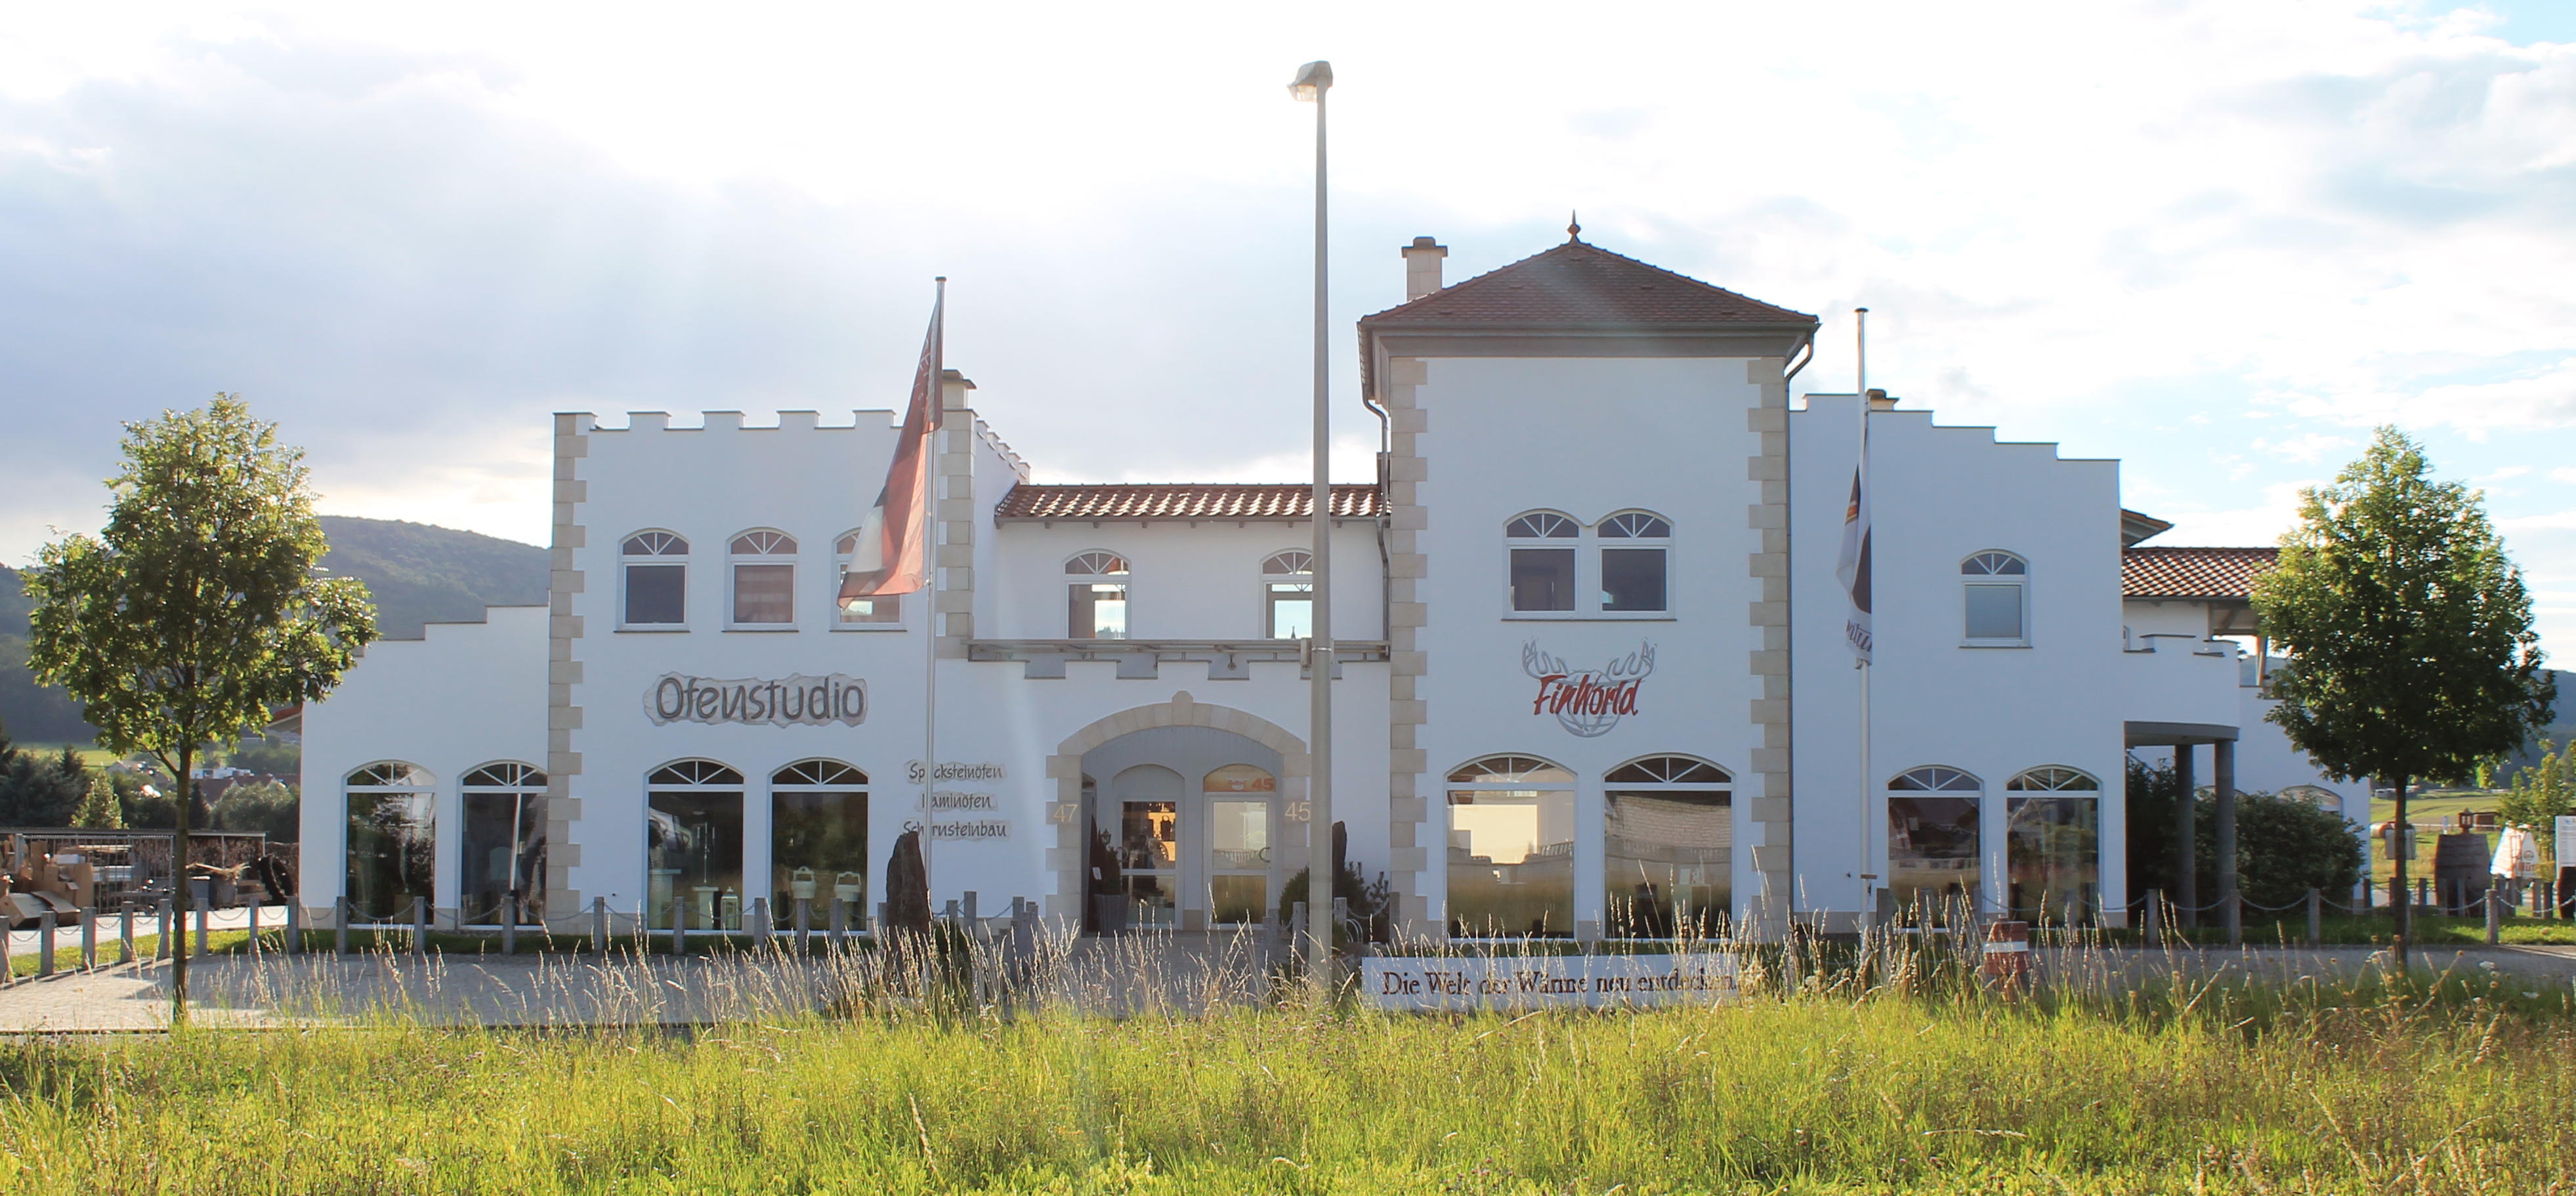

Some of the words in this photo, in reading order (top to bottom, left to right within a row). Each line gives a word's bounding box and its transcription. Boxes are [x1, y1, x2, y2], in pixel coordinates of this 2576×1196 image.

[656, 677, 864, 721] Ofenstudio
[908, 762, 1002, 782] Spcksteinöfen
[1053, 804, 1078, 823] 47
[1284, 801, 1311, 821] 45
[903, 821, 1007, 837] Schrnsteinbau
[1382, 972, 1420, 994] Die
[1425, 972, 1471, 995] Welt
